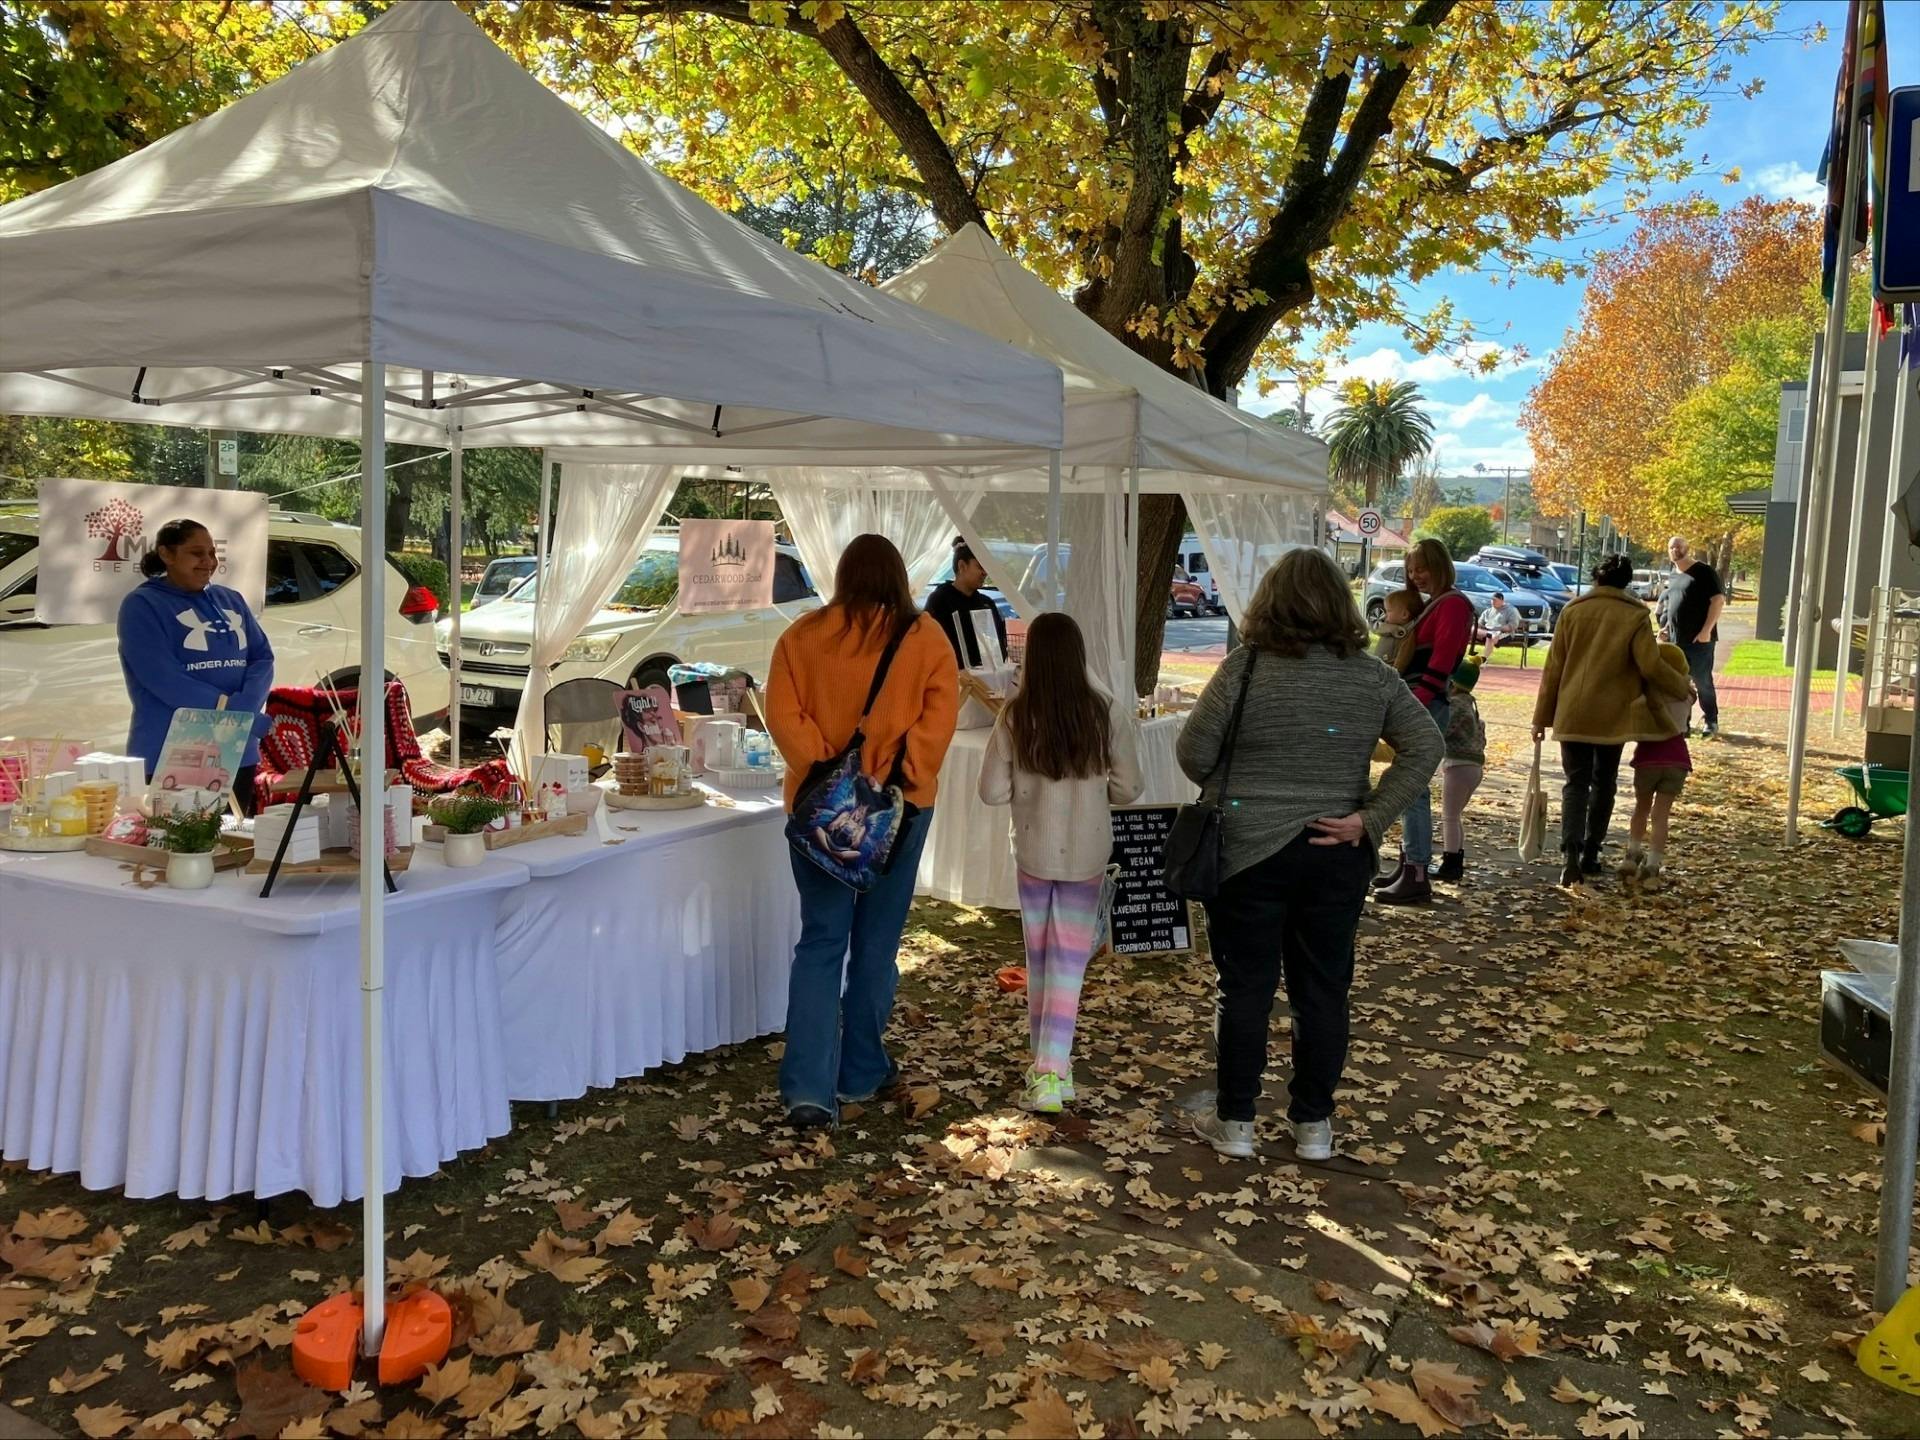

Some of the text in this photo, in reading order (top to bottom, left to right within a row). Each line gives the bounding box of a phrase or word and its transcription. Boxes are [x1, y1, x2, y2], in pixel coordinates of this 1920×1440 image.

[220, 443, 235, 452] 2P
[1363, 518, 1378, 529] 50
[692, 573, 745, 585] CEDARWOOD
[223, 659, 247, 668] ARMO
[1125, 814, 1143, 822] LITTLE
[1147, 813, 1163, 821] PIGGY
[1113, 821, 1168, 832] ONT COME TO THE
[1134, 833, 1157, 841] BECAUSE
[1152, 844, 1163, 853] ARE
[1130, 857, 1154, 867] VEGAN
[1141, 868, 1148, 877] WE
[1153, 867, 1166, 876] WEN
[1126, 880, 1142, 889] GRAND
[1128, 891, 1167, 903] THROUGH THE
[1113, 899, 1179, 916] LAVENDER FIELDS!
[1117, 916, 1174, 928] AND LIVED HAPPILY
[1122, 929, 1169, 940] EVER AFTER
[1115, 940, 1171, 953] CEDARWOOD ROAD
